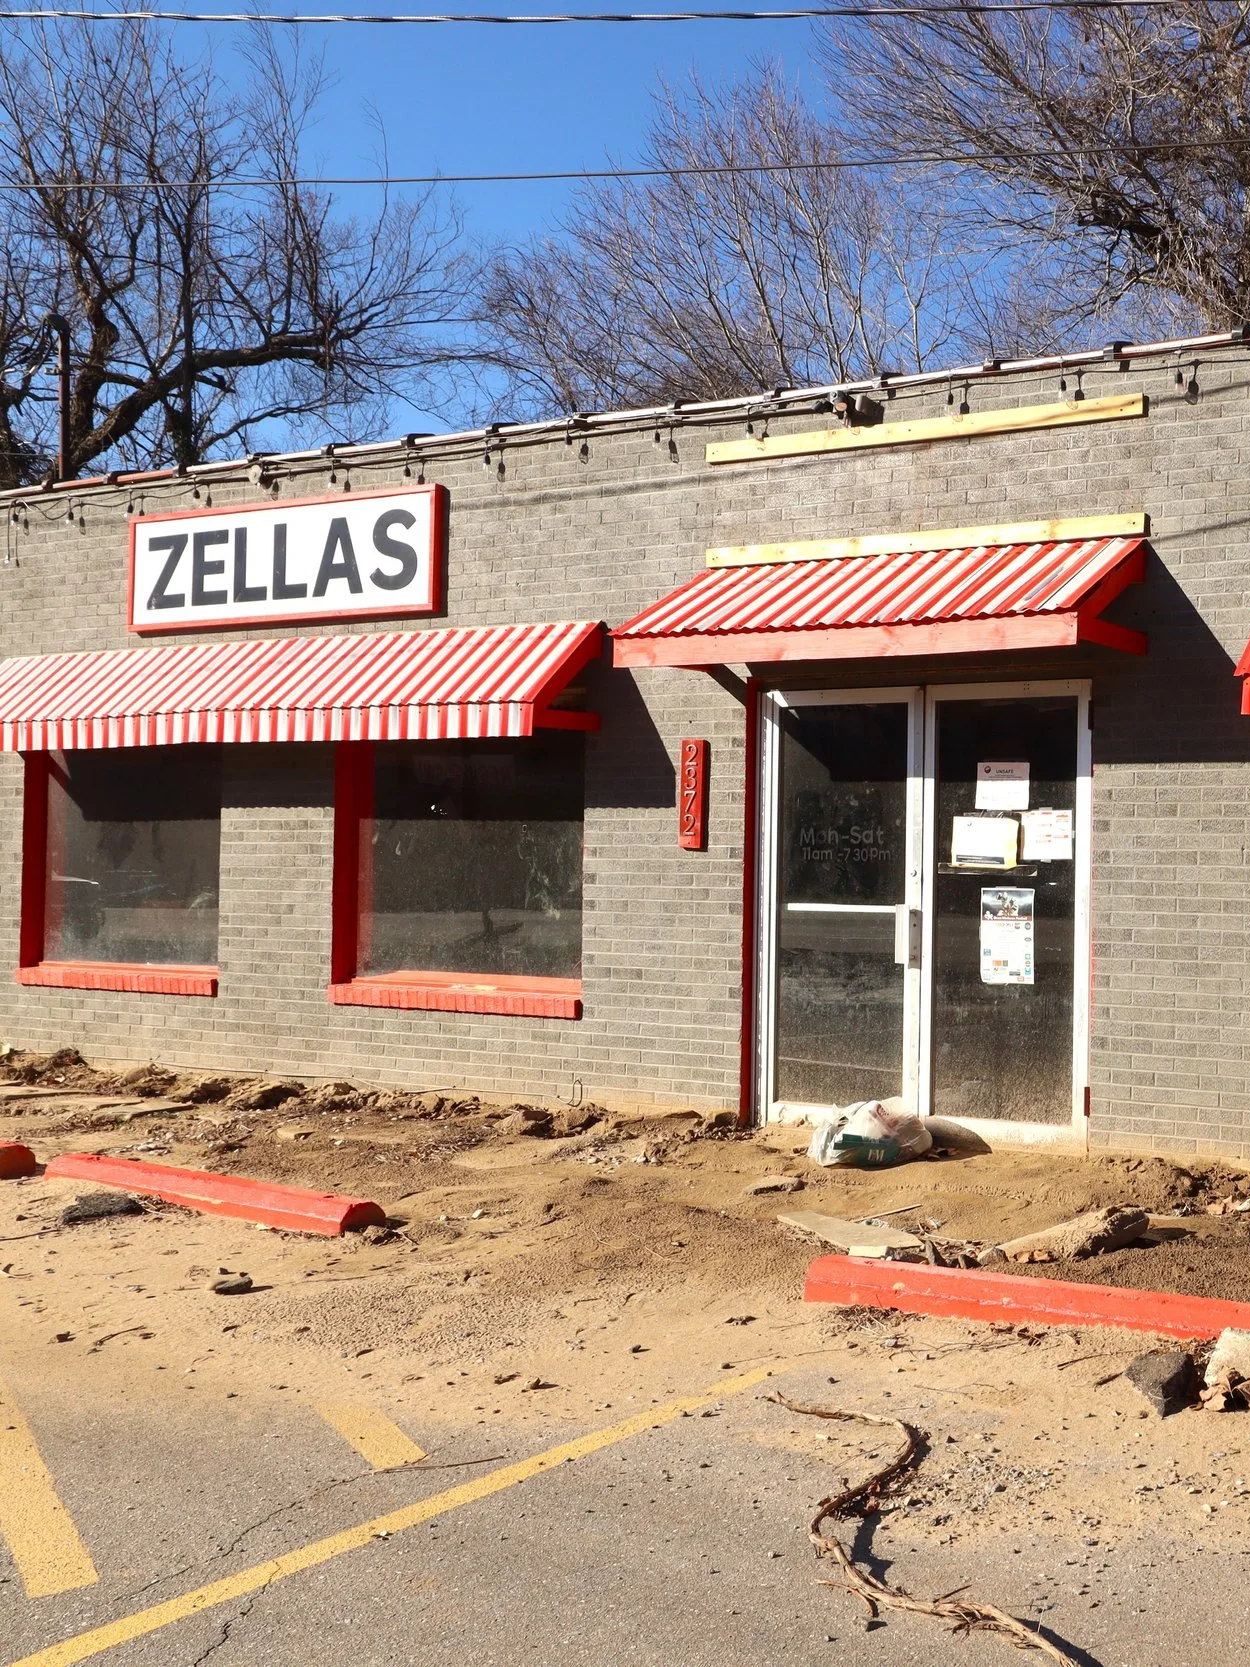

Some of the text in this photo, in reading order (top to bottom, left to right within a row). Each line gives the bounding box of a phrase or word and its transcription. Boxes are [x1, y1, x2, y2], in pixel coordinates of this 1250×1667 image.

[147, 509, 419, 611] ZELLAS
[682, 743, 699, 837] 2372
[802, 847, 833, 861] 11am
